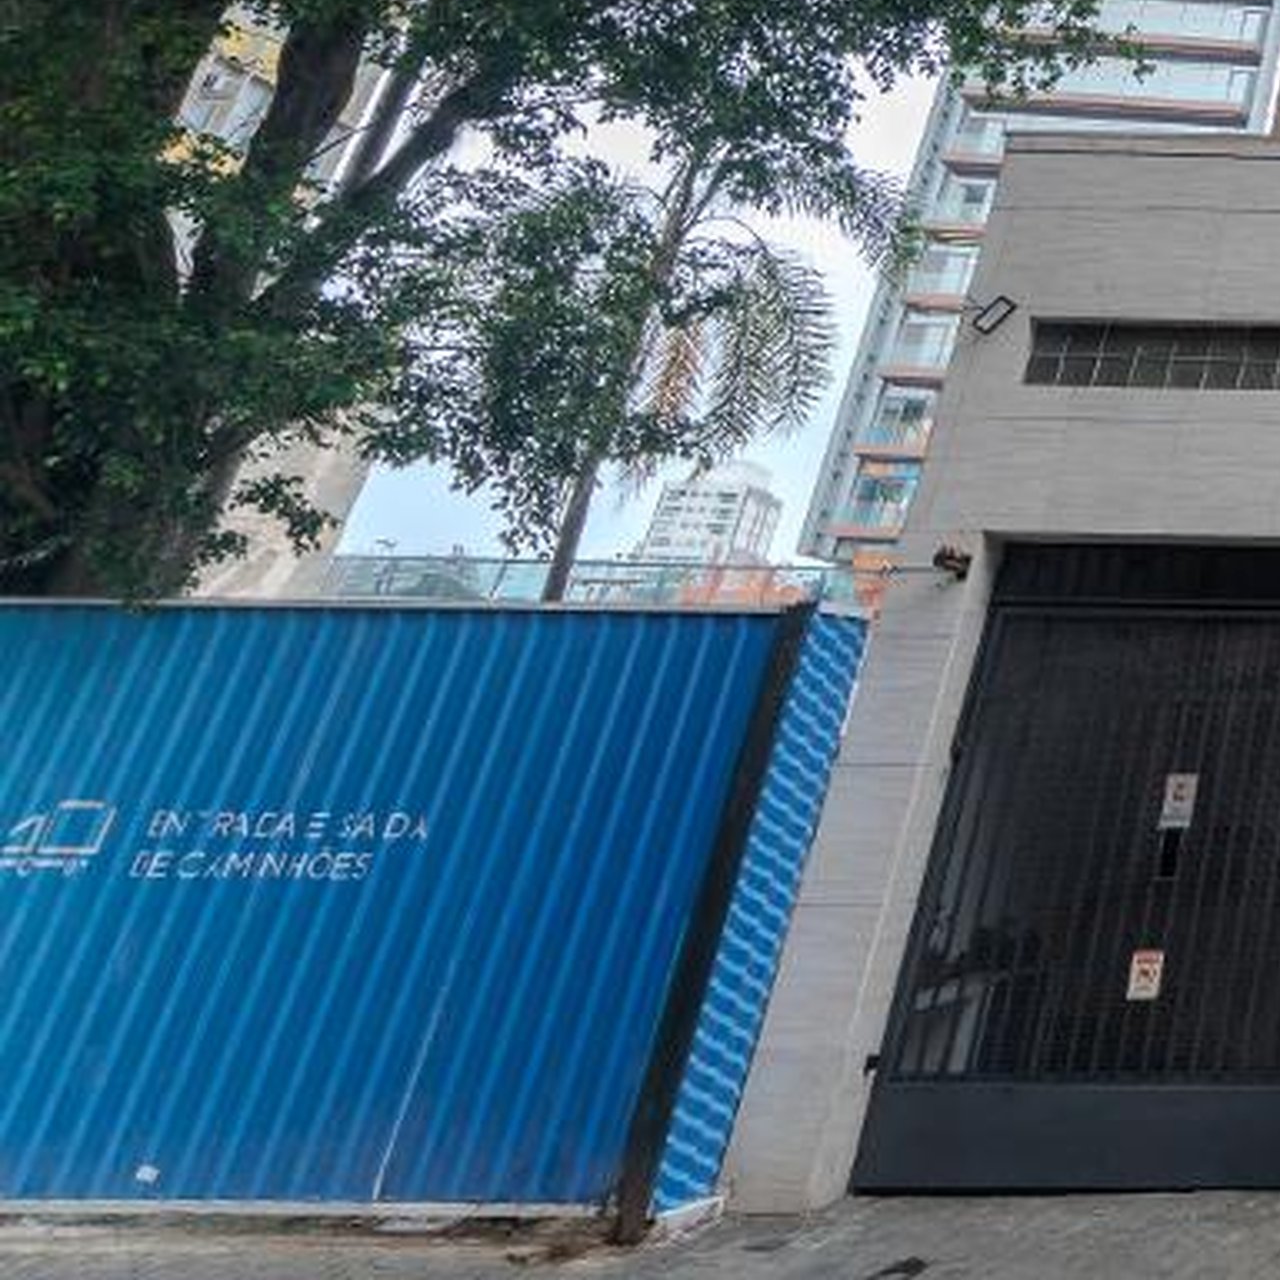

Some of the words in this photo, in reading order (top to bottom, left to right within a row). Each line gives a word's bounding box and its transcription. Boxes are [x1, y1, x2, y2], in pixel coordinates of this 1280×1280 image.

[147, 810, 296, 839] ENRADA
[304, 812, 331, 839] E
[338, 809, 429, 840] SADA
